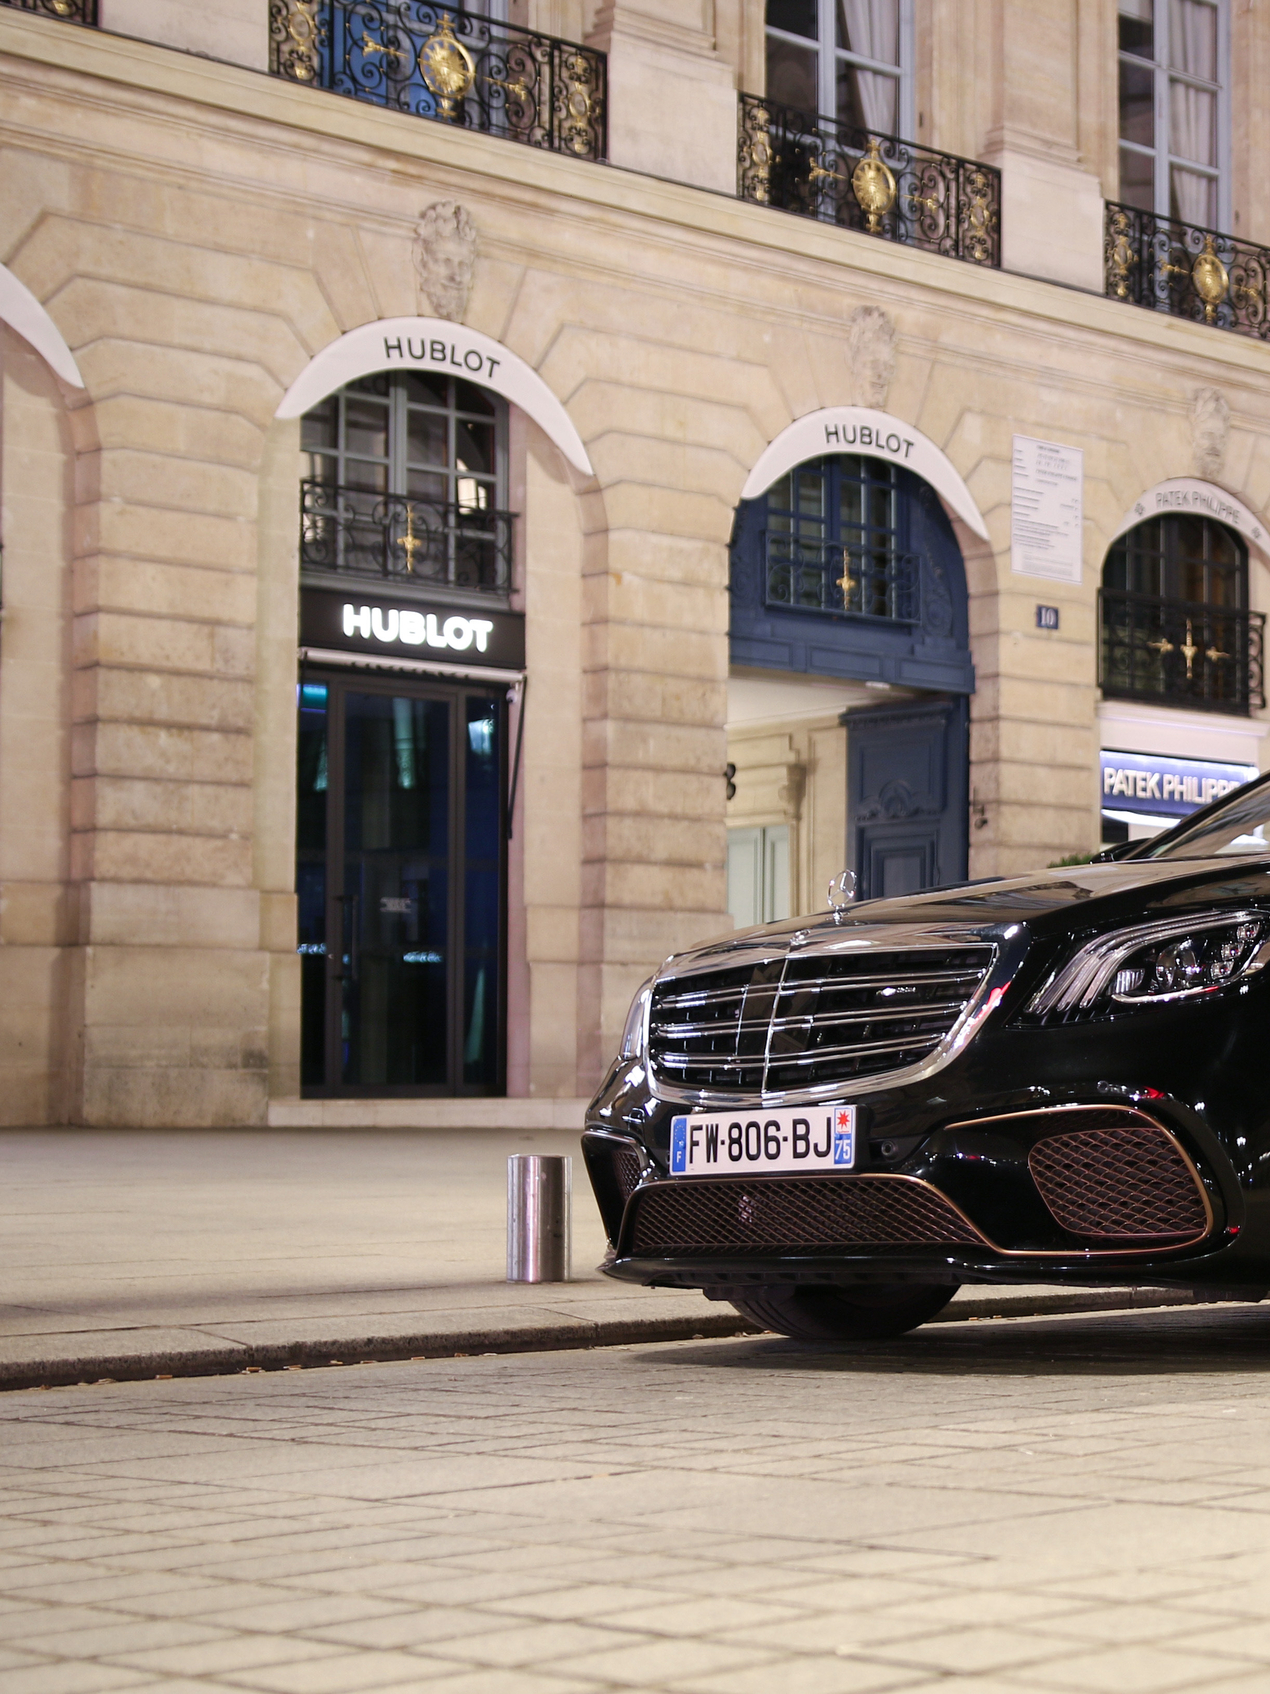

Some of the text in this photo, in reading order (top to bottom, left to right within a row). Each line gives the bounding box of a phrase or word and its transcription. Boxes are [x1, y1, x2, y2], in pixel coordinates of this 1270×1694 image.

[384, 336, 501, 378] HUBLOT
[824, 423, 915, 458] HUBLOT
[1155, 490, 1241, 525] PATEK PHILIPPE
[342, 602, 494, 654] HUBLOT
[1040, 606, 1057, 627] 10
[1103, 767, 1241, 804] PATEK PHILIPP
[676, 1151, 682, 1163] F
[689, 1116, 832, 1164] FW-806-BJ
[835, 1139, 851, 1160] 75
